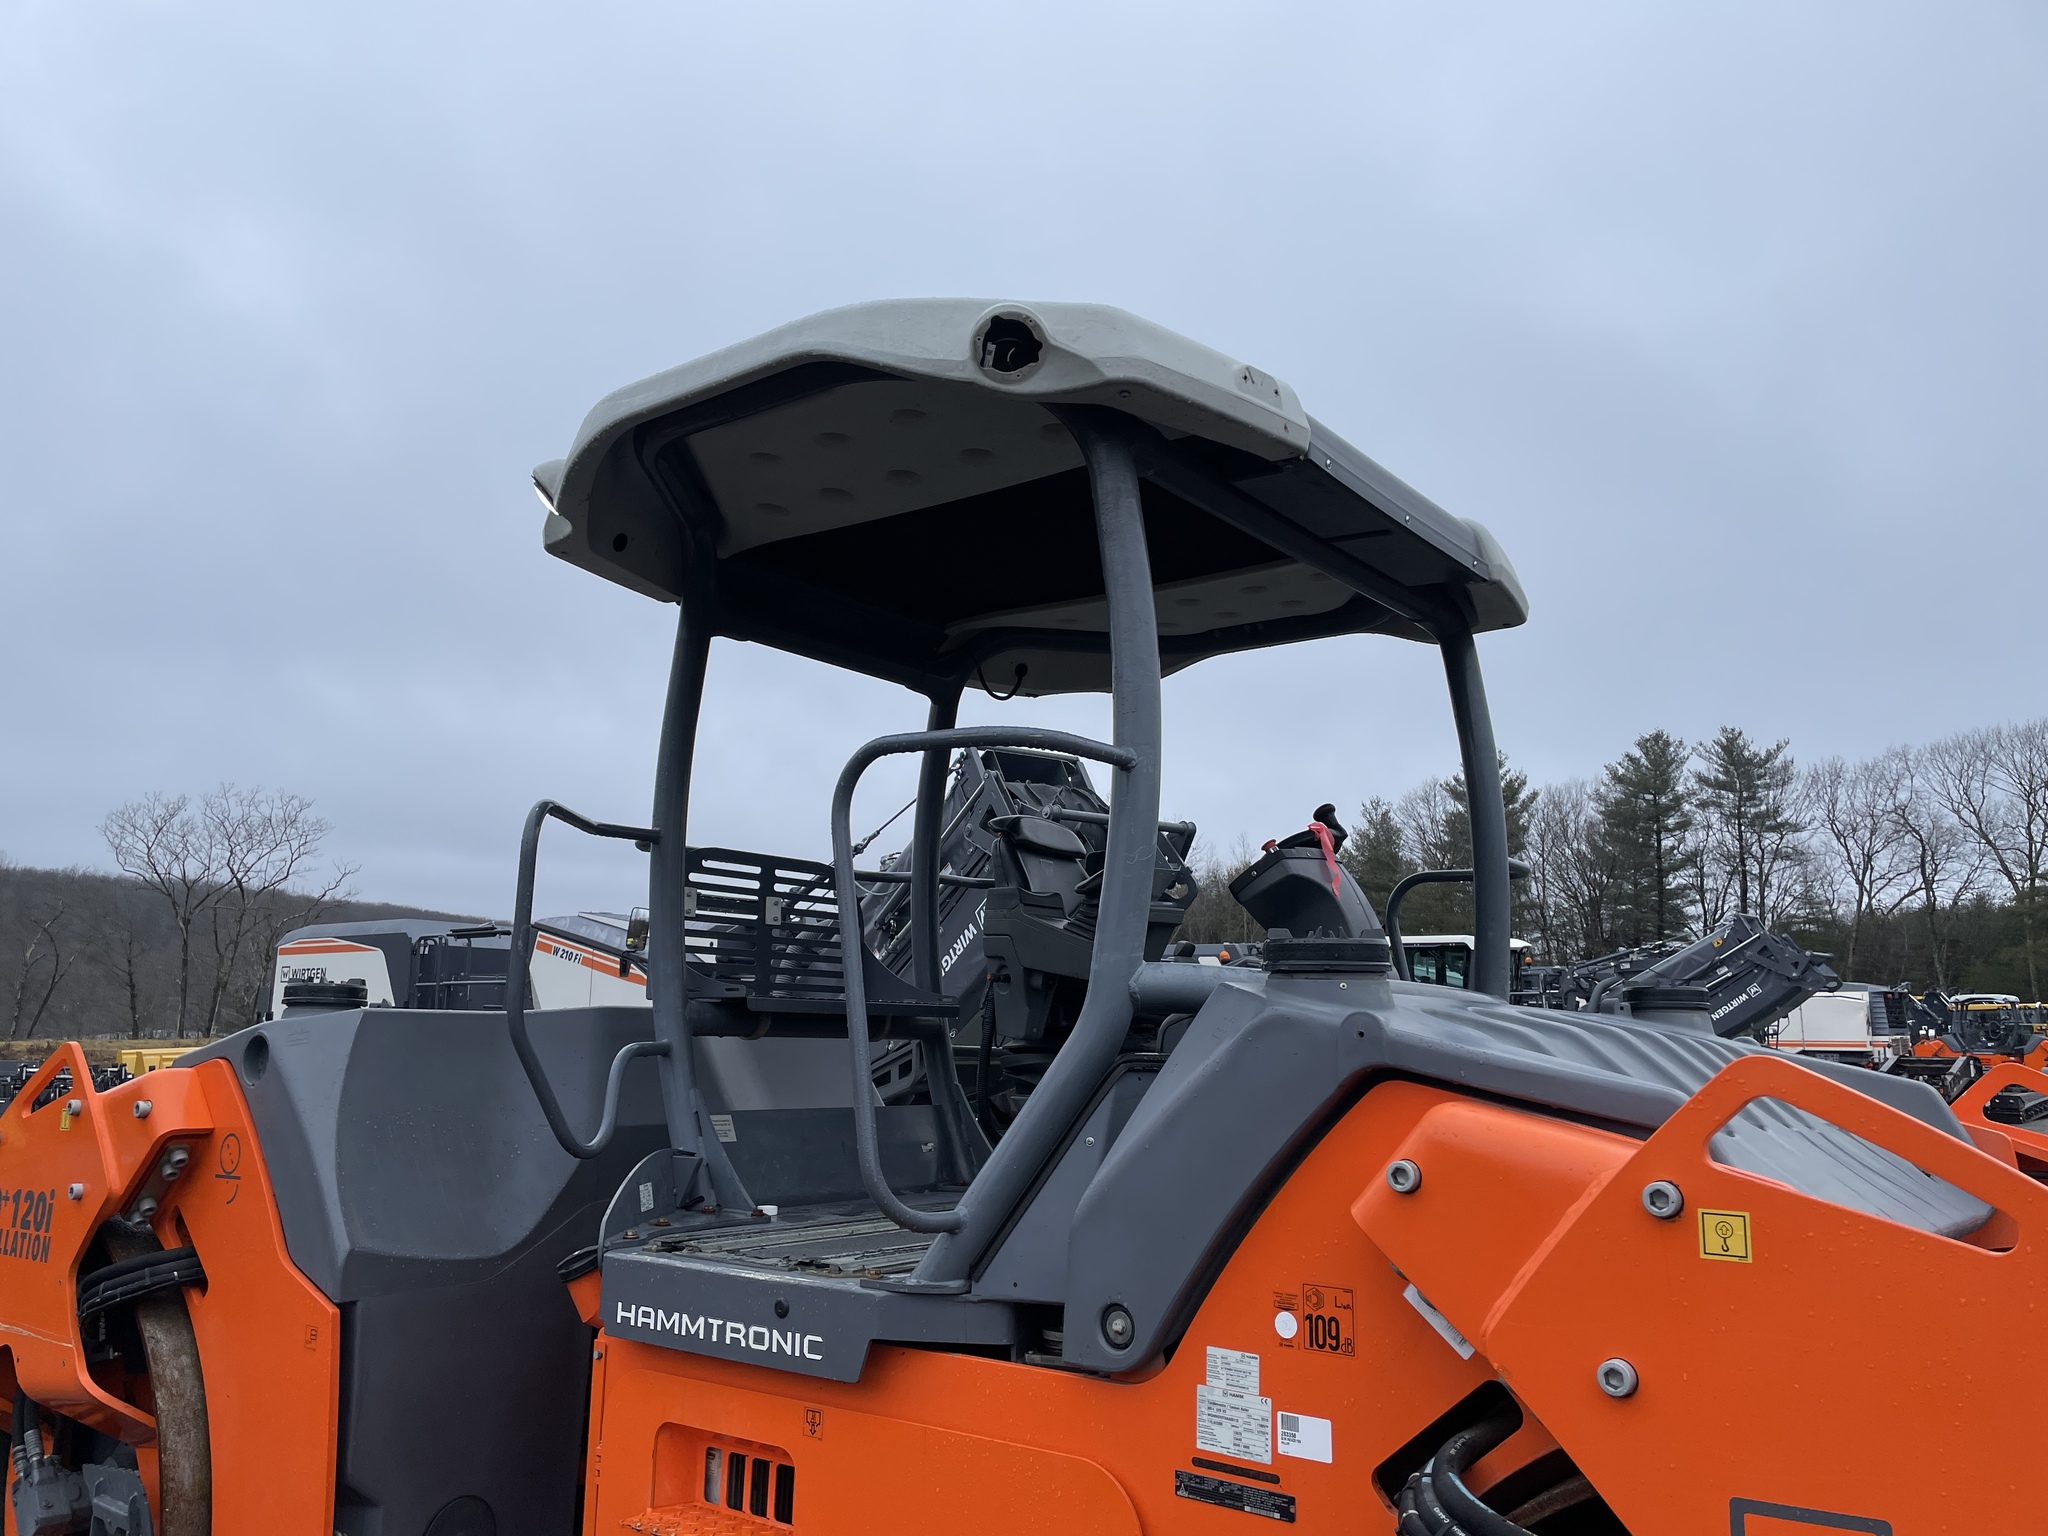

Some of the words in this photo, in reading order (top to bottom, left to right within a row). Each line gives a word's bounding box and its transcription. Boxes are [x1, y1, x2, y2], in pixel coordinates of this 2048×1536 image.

[552, 945, 561, 956] W
[560, 949, 574, 963] 210
[573, 954, 583, 965] Fi
[292, 967, 327, 980] WIRTGEN
[1711, 993, 1749, 1021] WIRTGEN
[0, 1187, 56, 1233] +120i
[616, 1301, 824, 1361] HAMMTRONIC
[1305, 1313, 1341, 1352] 109
[1341, 1337, 1354, 1354] dB
